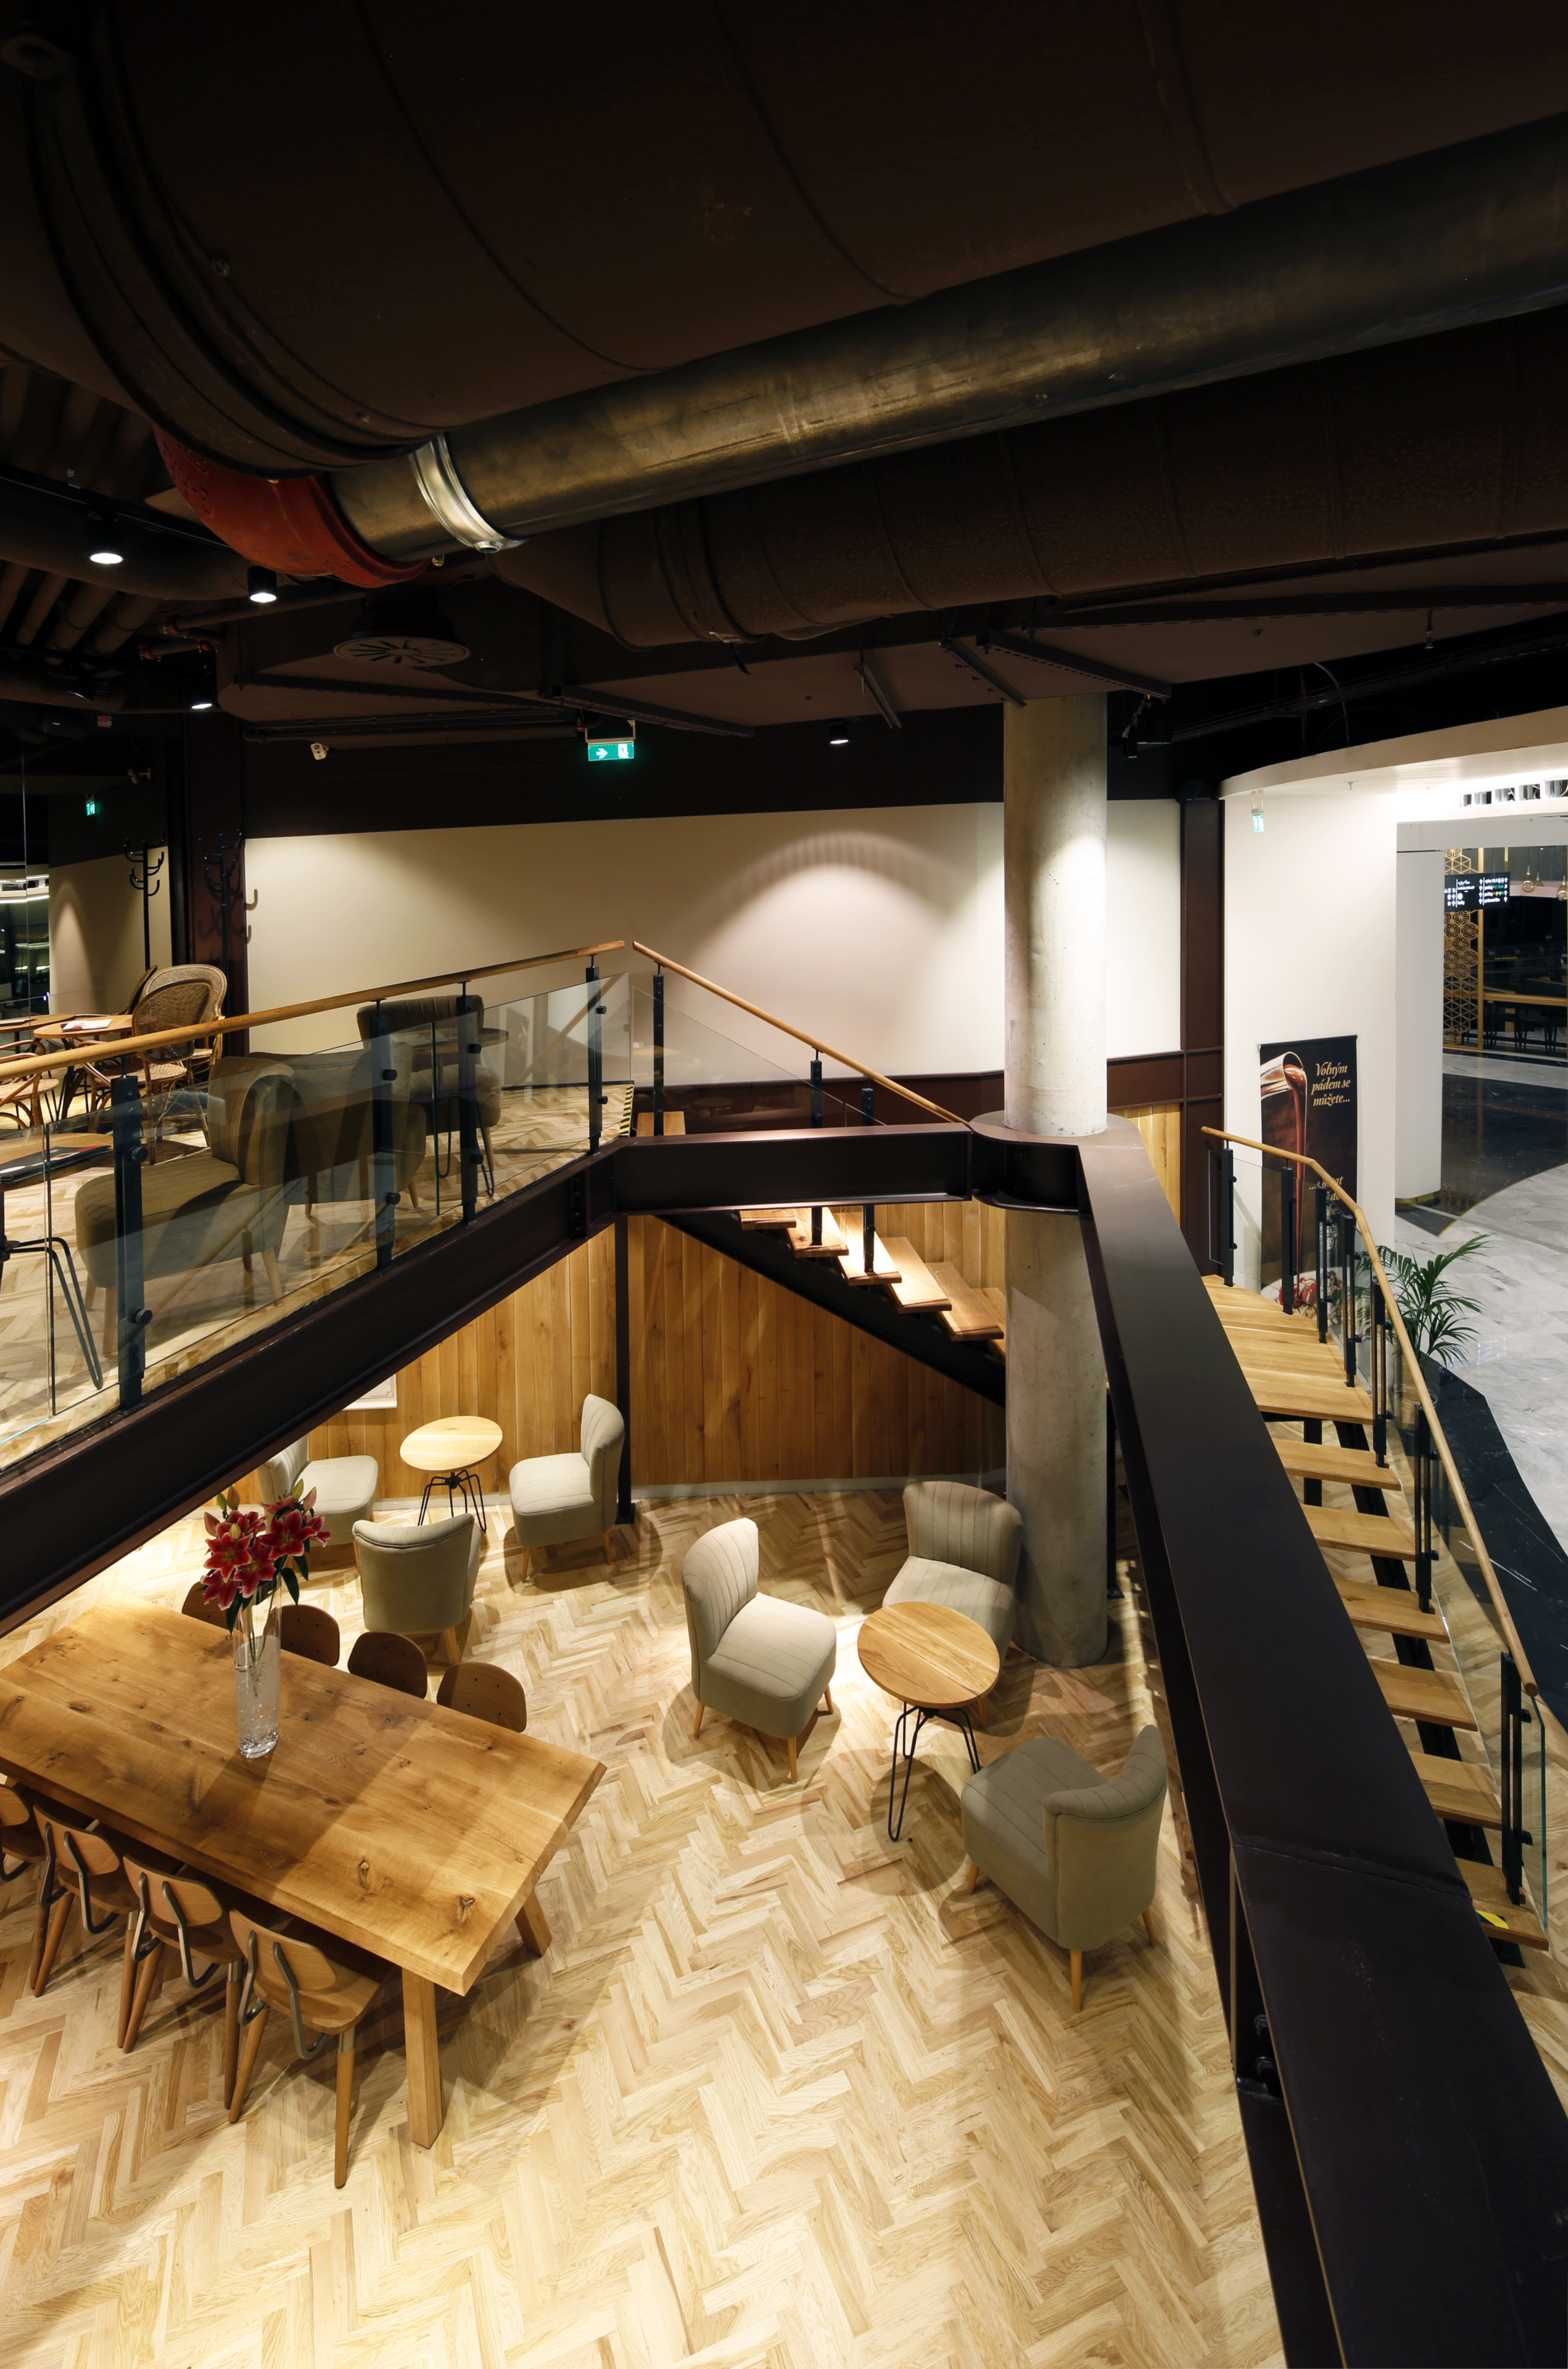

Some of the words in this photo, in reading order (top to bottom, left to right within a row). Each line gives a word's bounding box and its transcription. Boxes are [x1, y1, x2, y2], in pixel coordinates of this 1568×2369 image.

[1315, 1062, 1348, 1079] Volným
[1311, 1077, 1341, 1095] pádem
[1341, 1080, 1351, 1088] se
[1313, 1093, 1350, 1106] můžete...
